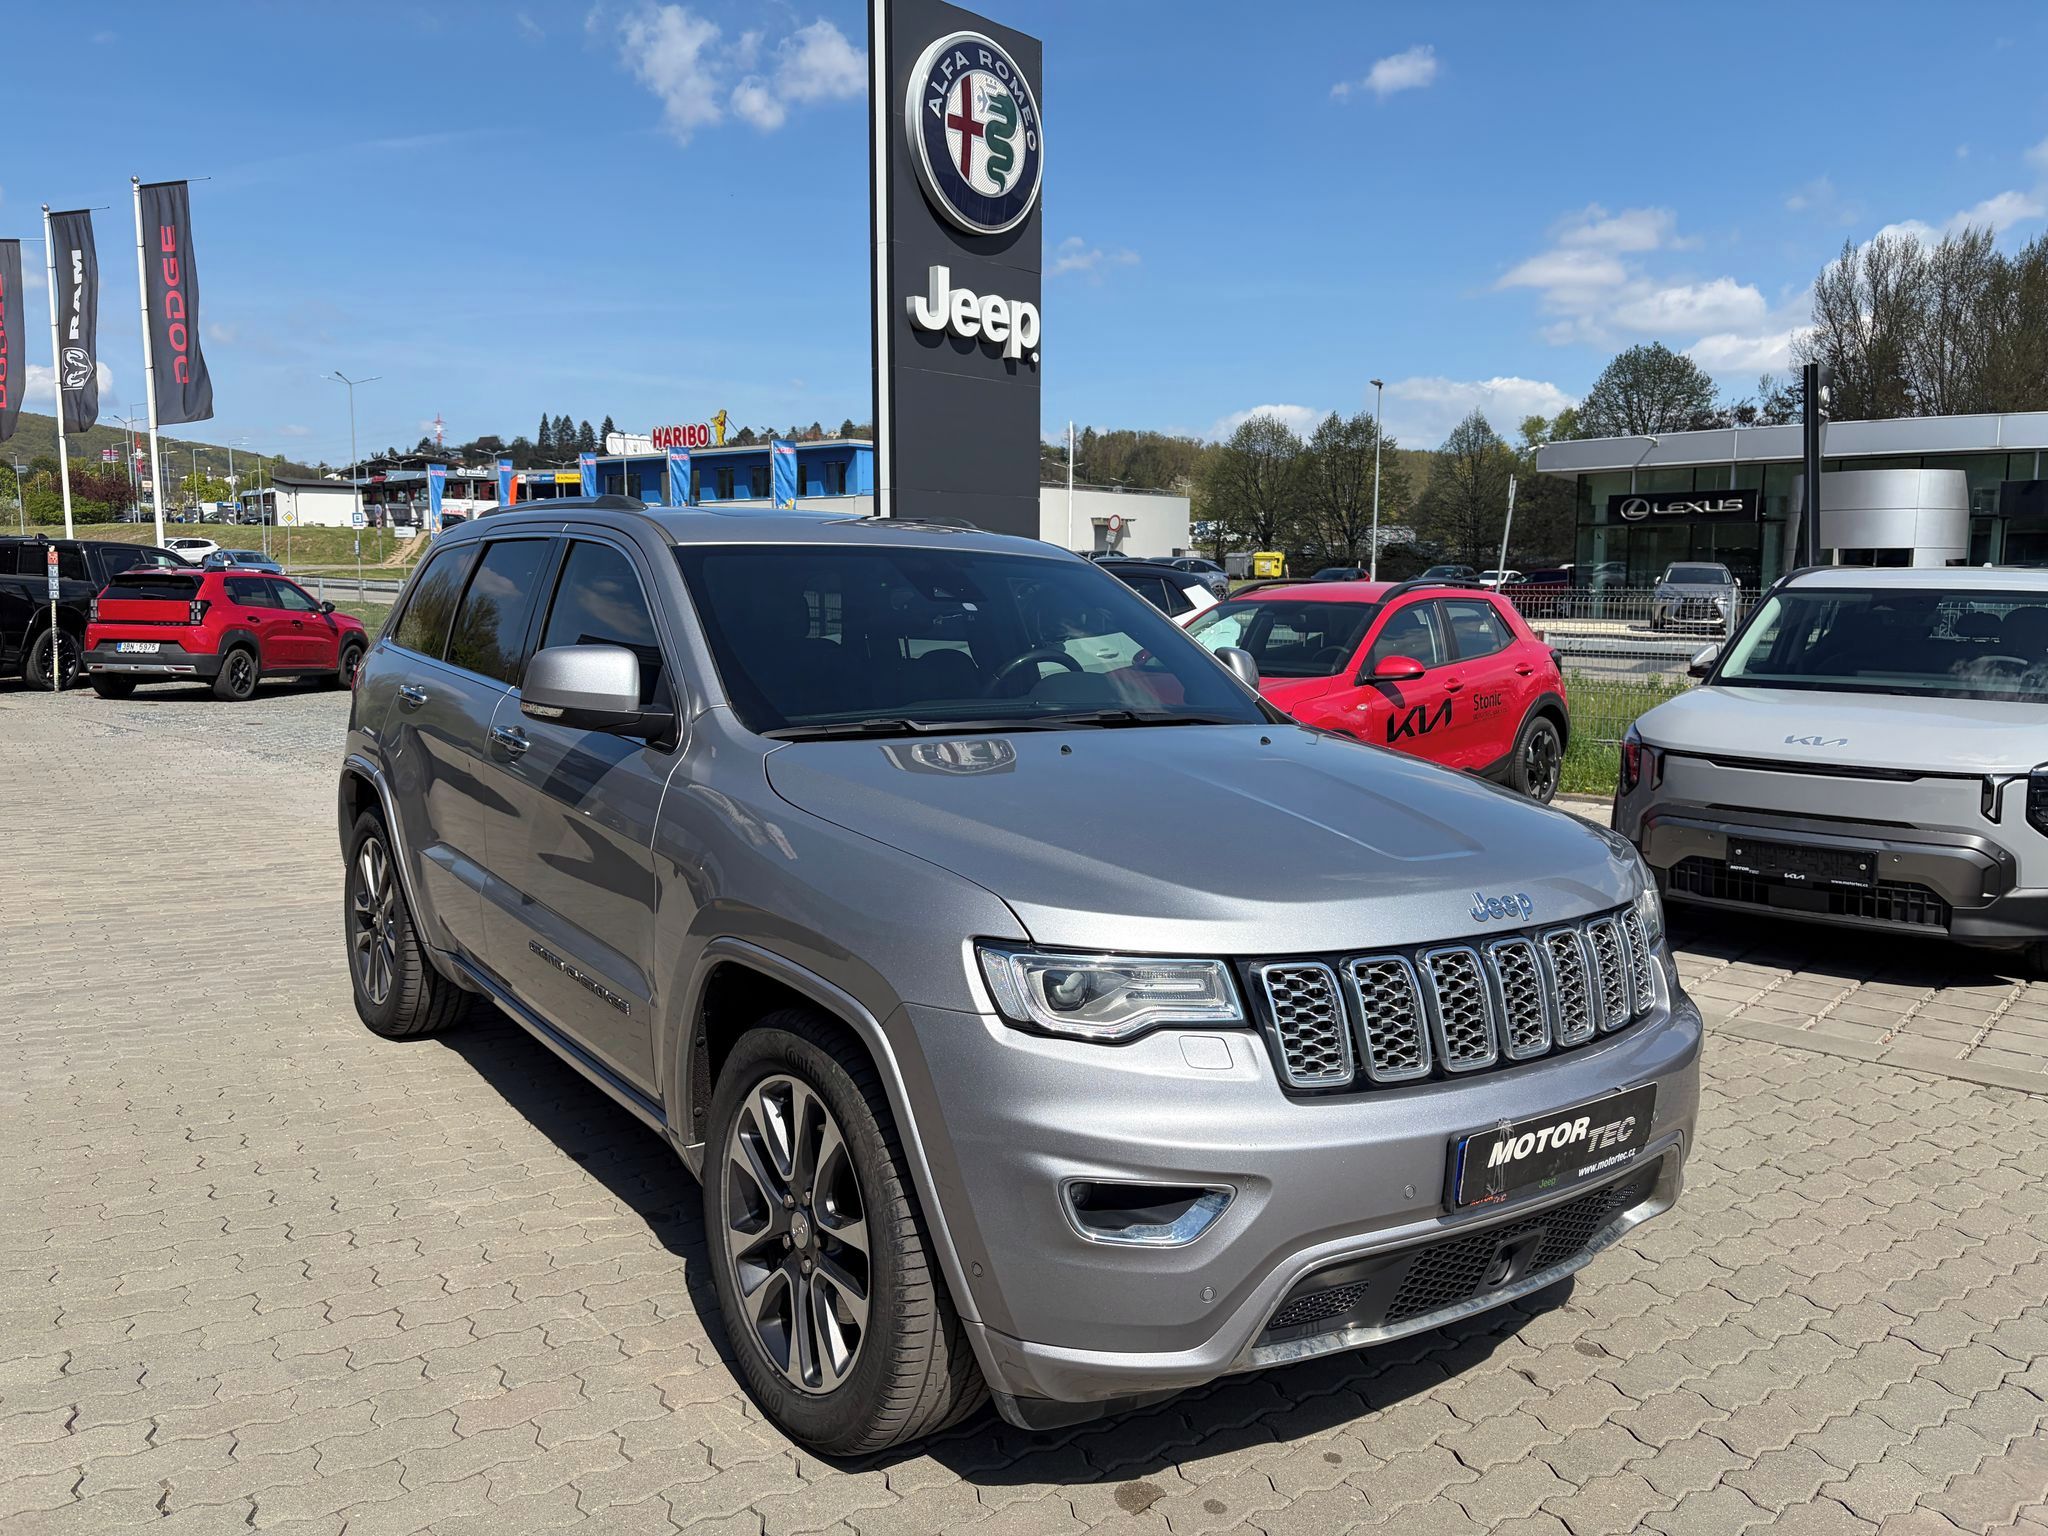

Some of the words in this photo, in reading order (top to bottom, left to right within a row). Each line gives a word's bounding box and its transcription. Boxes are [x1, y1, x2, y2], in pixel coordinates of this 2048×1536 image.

[929, 50, 970, 119] ALFA
[978, 48, 1038, 152] ROMEO
[68, 249, 83, 340] RAM
[160, 225, 190, 384] DODGE
[652, 424, 709, 449] HARIBO
[1653, 499, 1743, 514] LEXUS
[1473, 690, 1502, 711] Stonic
[1387, 698, 1452, 743] KIA
[1784, 734, 1848, 747] KIA
[1468, 892, 1534, 922] Jeep
[1578, 1147, 1637, 1177] www.motortec.cz
